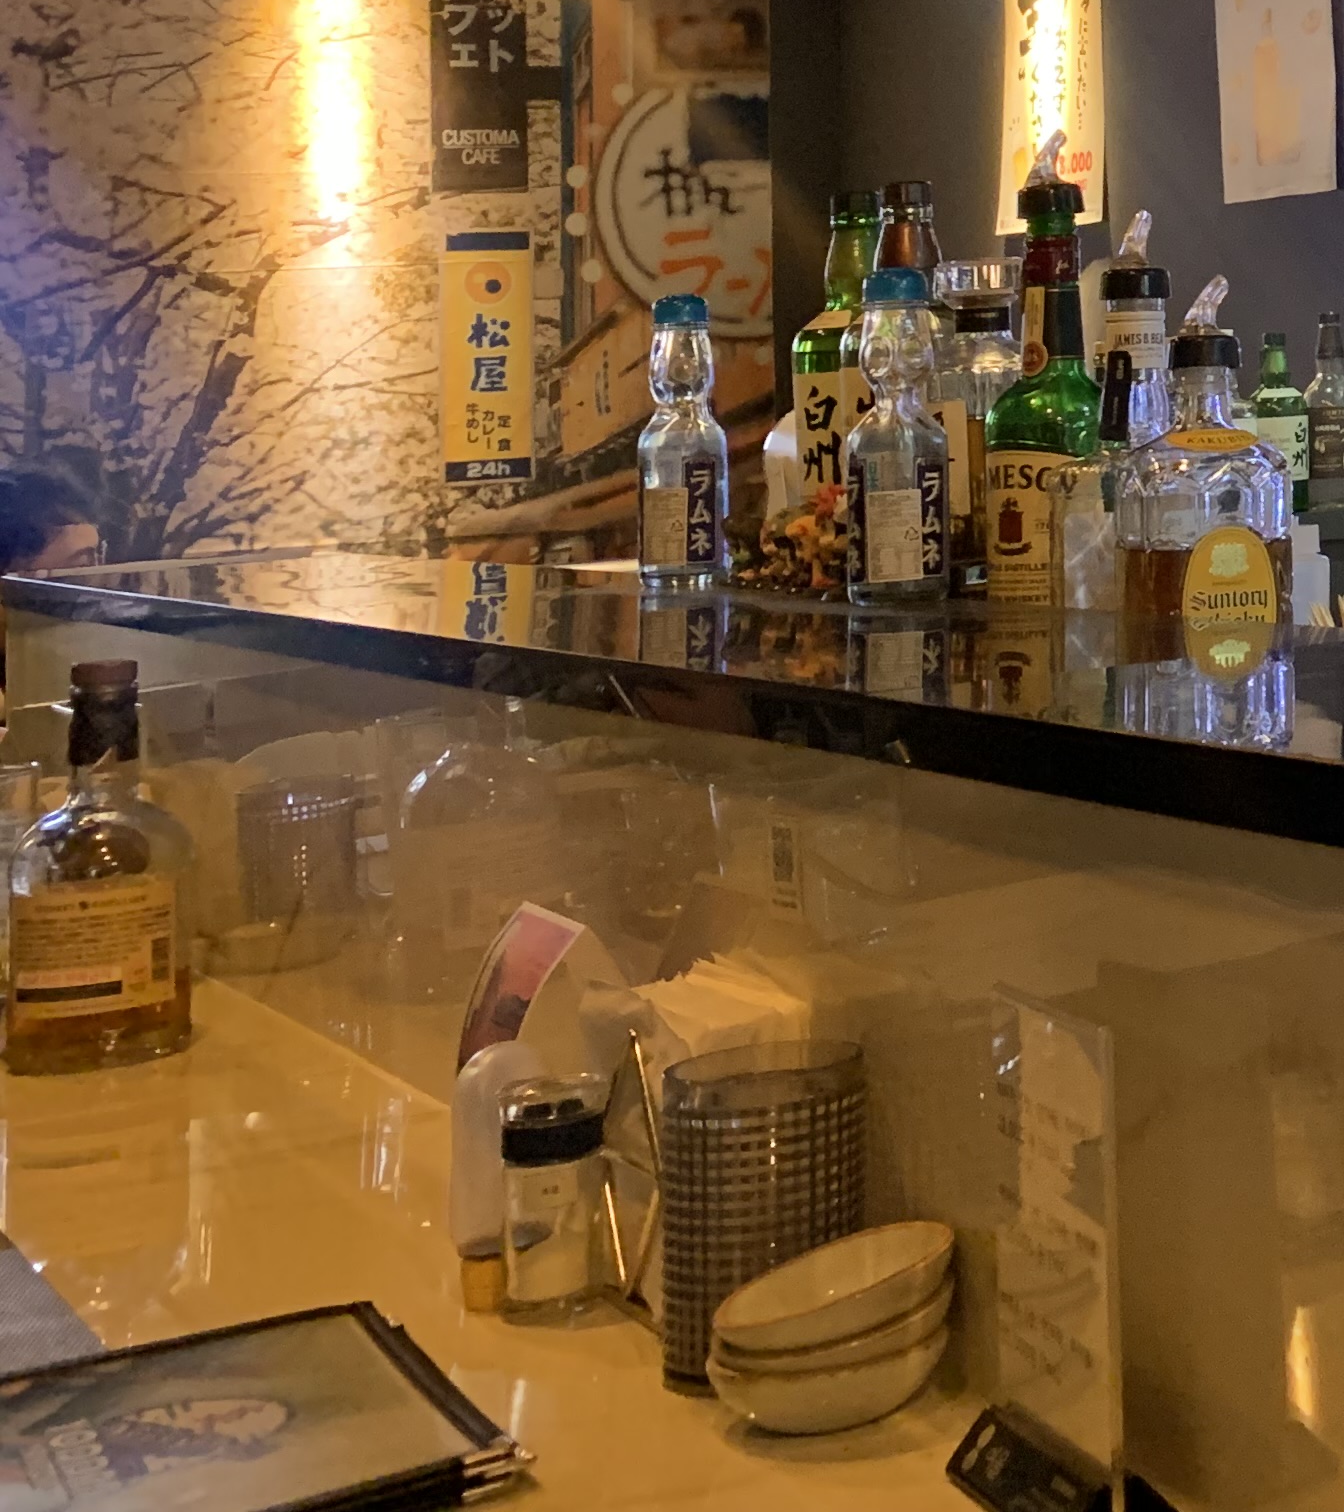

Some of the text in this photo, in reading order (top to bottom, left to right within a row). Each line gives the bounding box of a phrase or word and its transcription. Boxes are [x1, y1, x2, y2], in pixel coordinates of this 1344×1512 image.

[441, 129, 520, 146] CUSTOMA
[460, 148, 501, 165] CAFE
[467, 313, 512, 392] 松屋
[465, 402, 480, 444] 牛めし
[481, 409, 496, 450] カレー
[803, 385, 843, 485] 白州
[1291, 422, 1309, 469] 白州
[465, 462, 511, 479] 24h
[689, 469, 713, 557] ラムネ
[921, 471, 942, 569] ラムネ
[1190, 587, 1268, 611] Suntory
